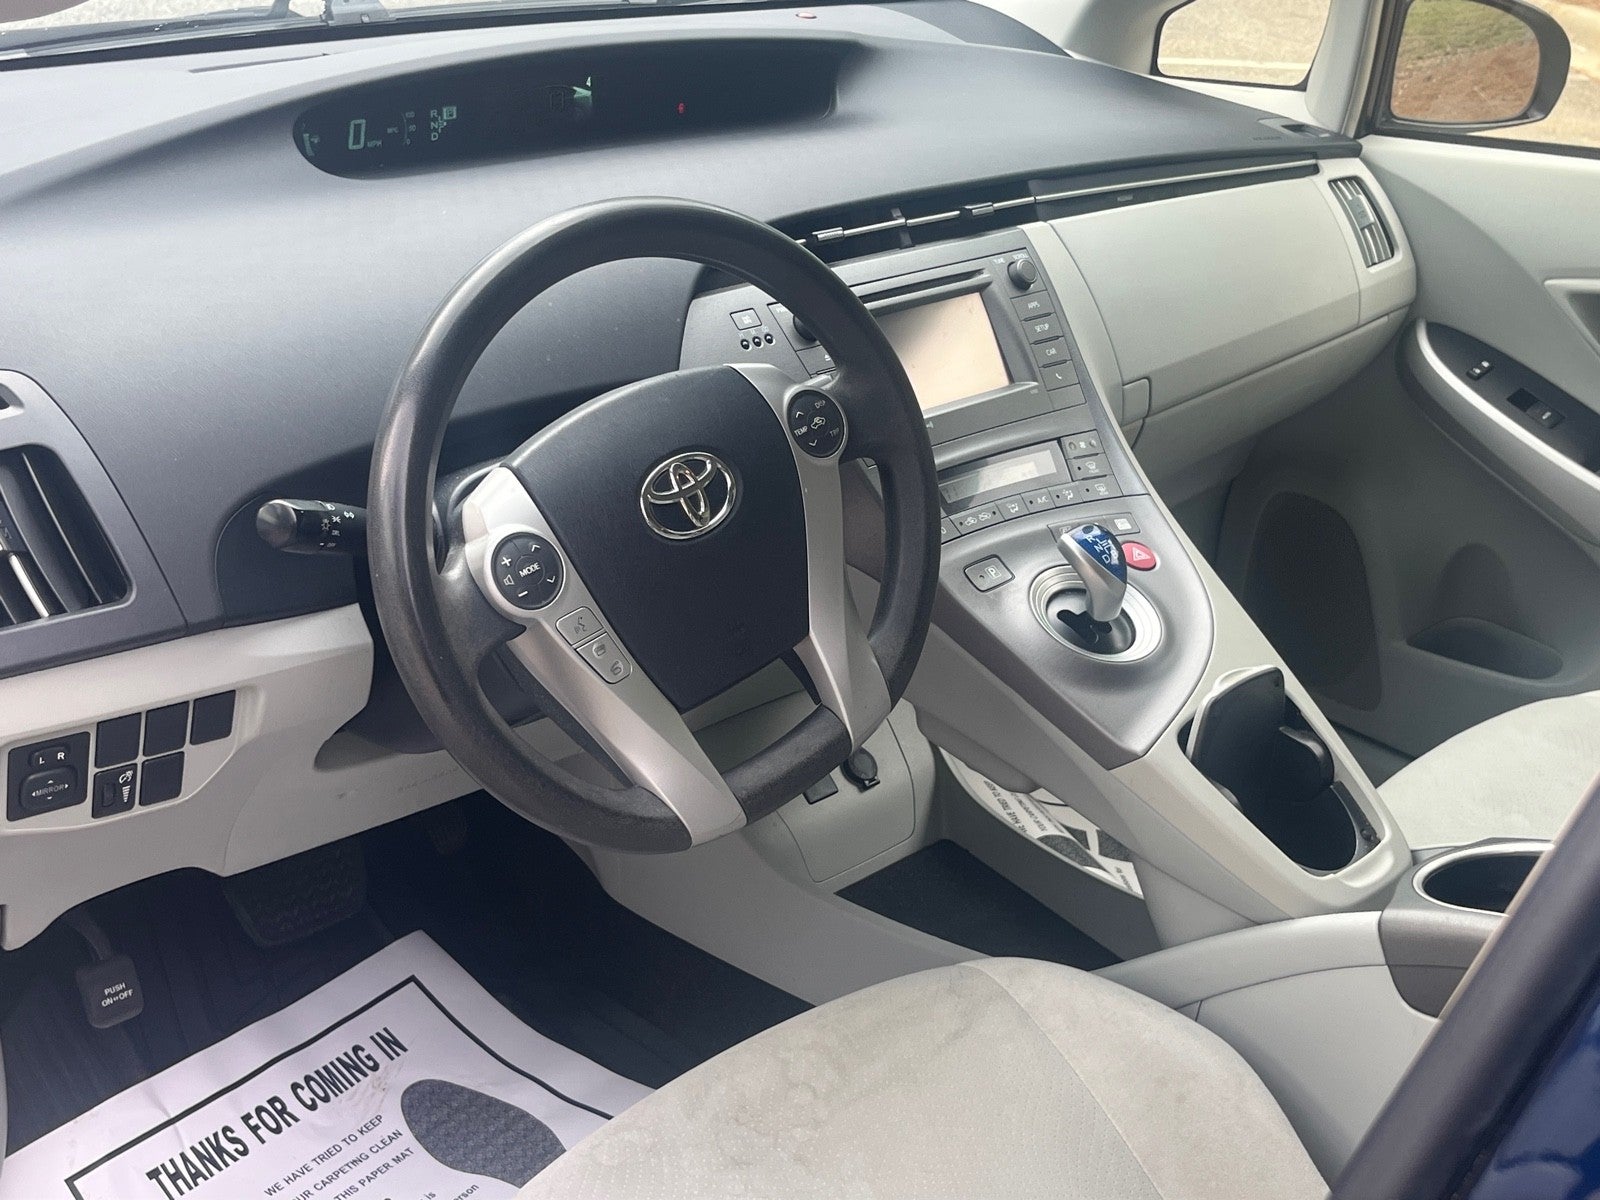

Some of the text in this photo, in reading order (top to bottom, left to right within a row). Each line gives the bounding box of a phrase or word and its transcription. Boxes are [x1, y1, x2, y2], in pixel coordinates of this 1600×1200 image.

[430, 110, 439, 119] R
[349, 119, 367, 150] 0
[430, 132, 439, 141] D
[1027, 301, 1041, 310] APPS
[1034, 322, 1050, 333] SETUP
[1045, 348, 1057, 356] CAR
[1101, 554, 1111, 564] D
[519, 562, 541, 579] MODE
[39, 751, 66, 765] L R
[35, 783, 66, 798] MIRROR
[104, 982, 126, 996] PUSH
[146, 1027, 409, 1200] THANKS FOR COMING IN
[264, 1114, 384, 1197] WE HAVE TRIED TO KEEP
[292, 1129, 404, 1200] UR CARPETING CLEAN
[334, 1146, 415, 1200] THIS PAPER MAT
